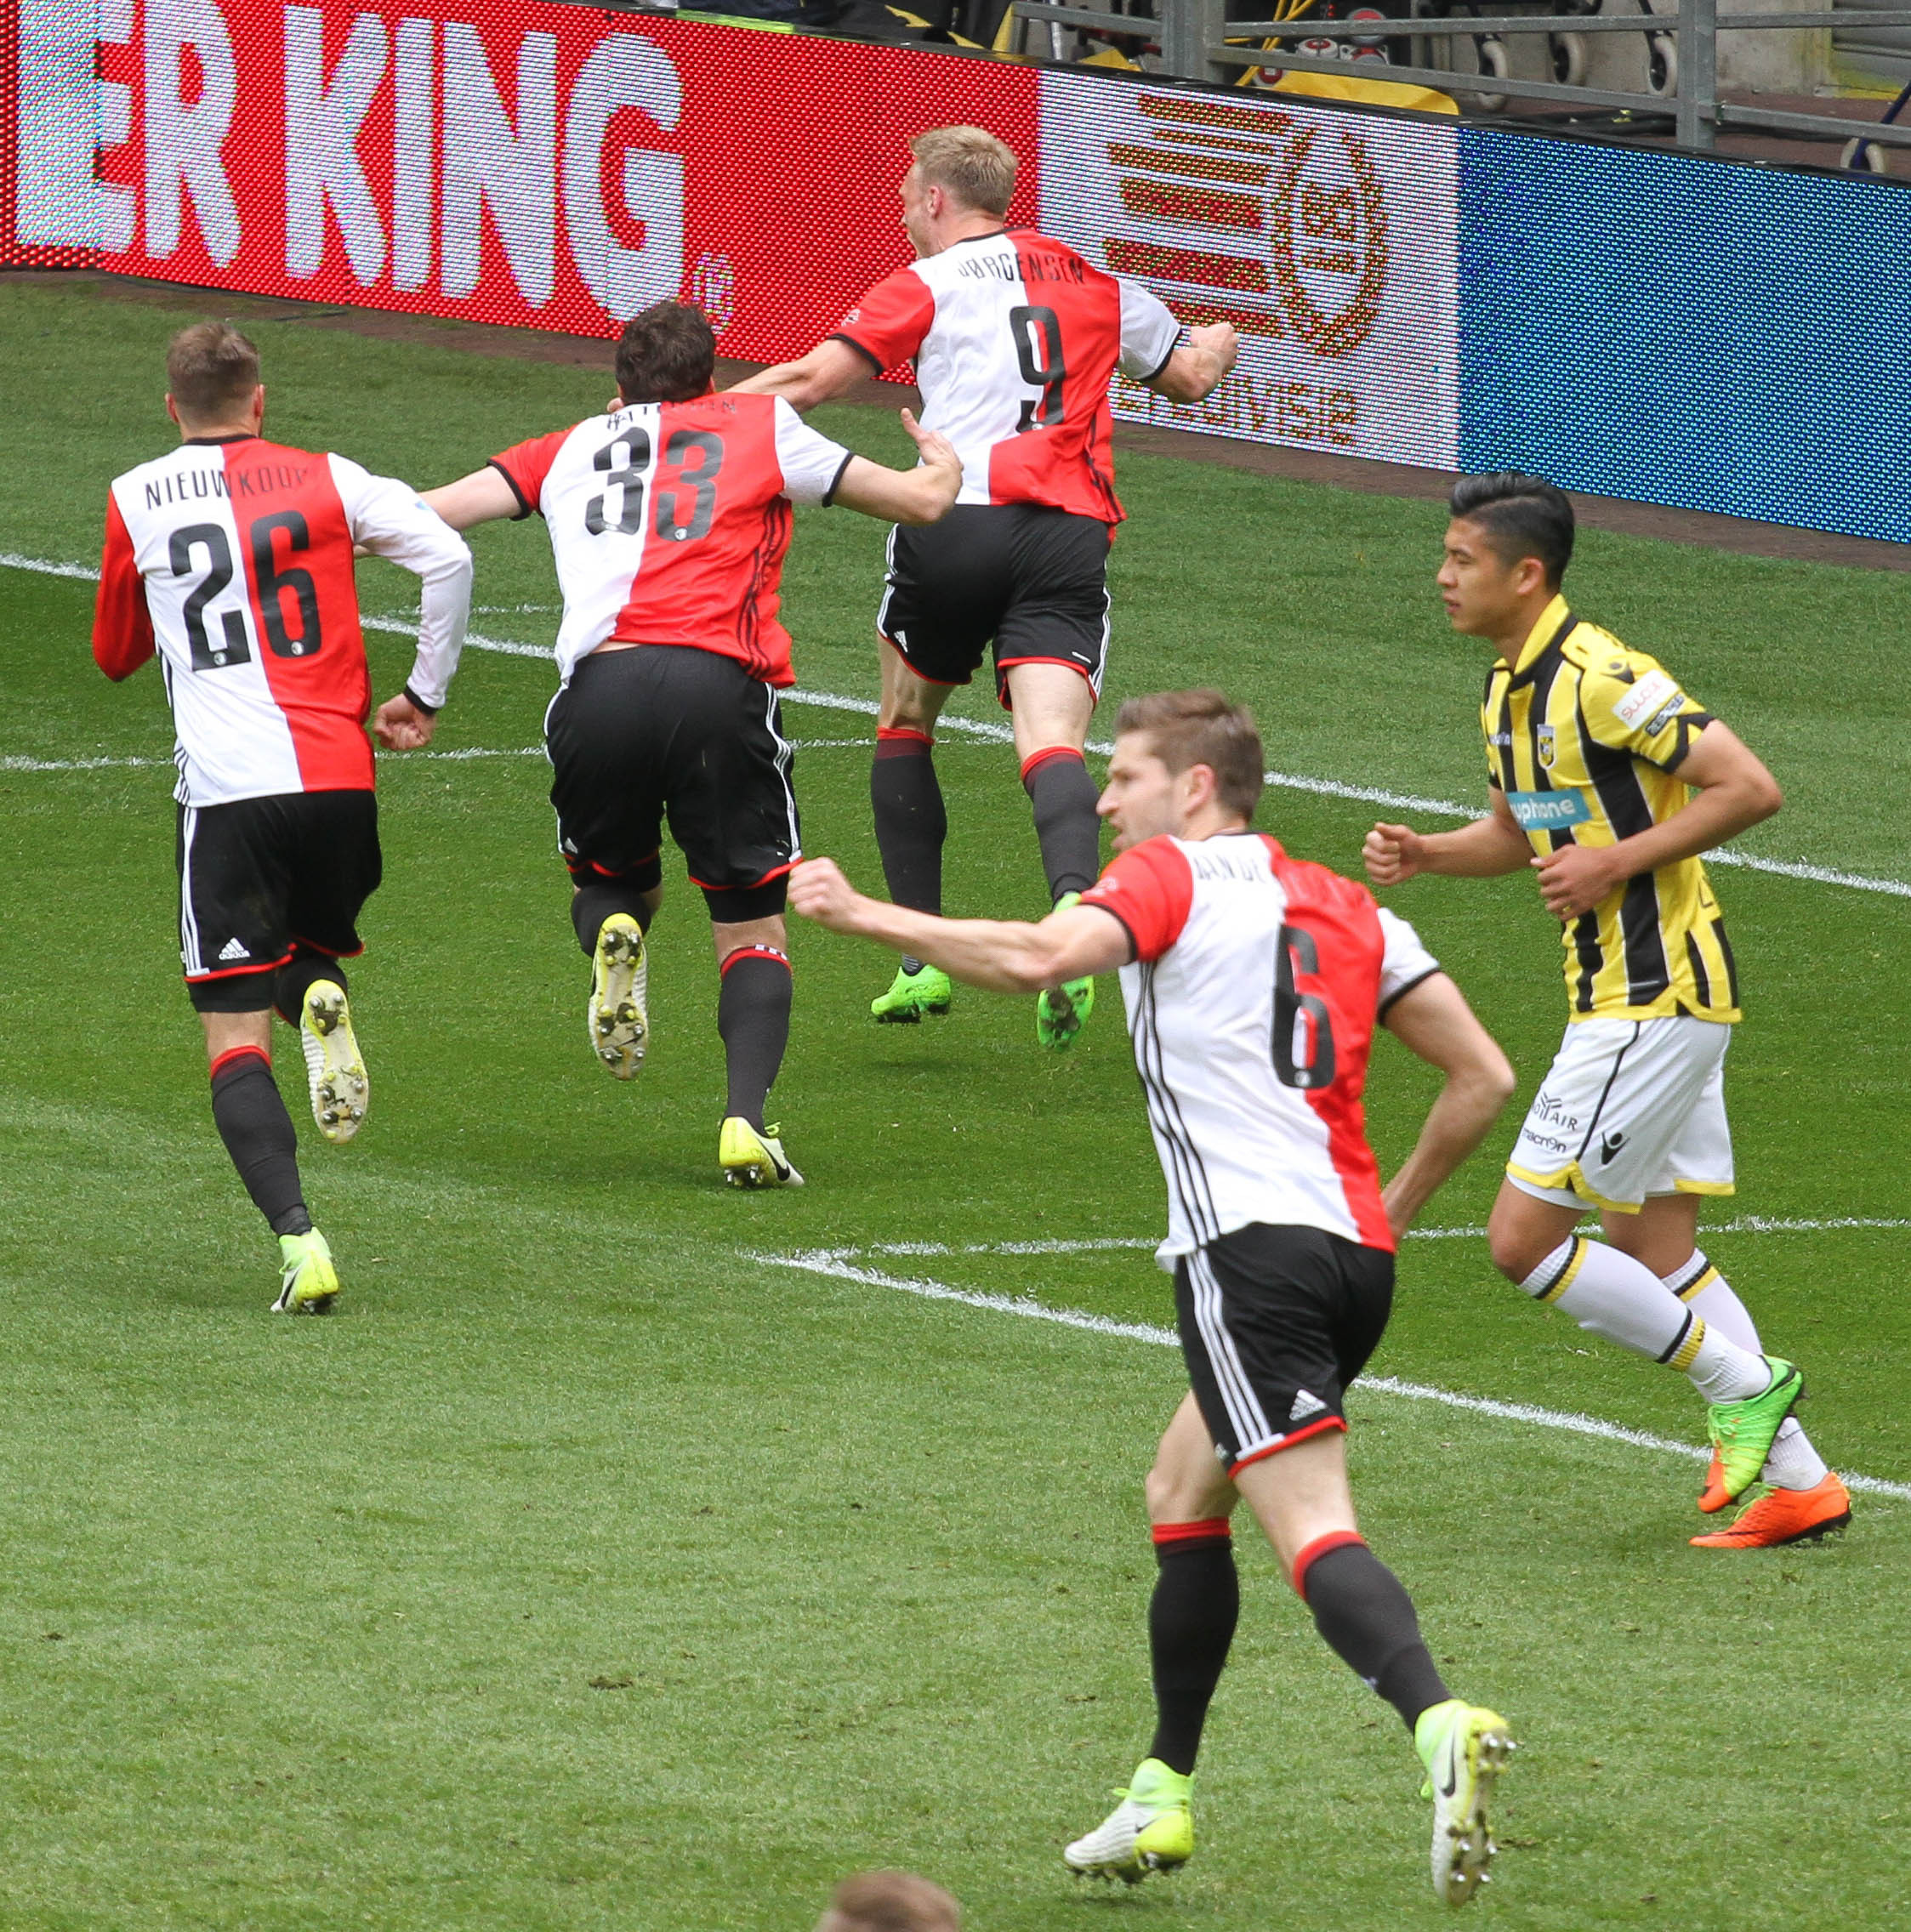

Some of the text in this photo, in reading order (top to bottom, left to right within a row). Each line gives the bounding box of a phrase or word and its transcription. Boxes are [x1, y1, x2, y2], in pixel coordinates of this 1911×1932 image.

[14, 0, 684, 323] ER KING
[1009, 305, 1066, 435] 9
[584, 426, 724, 542] 33
[168, 509, 321, 672] 26
[1271, 923, 1335, 1089] 6
